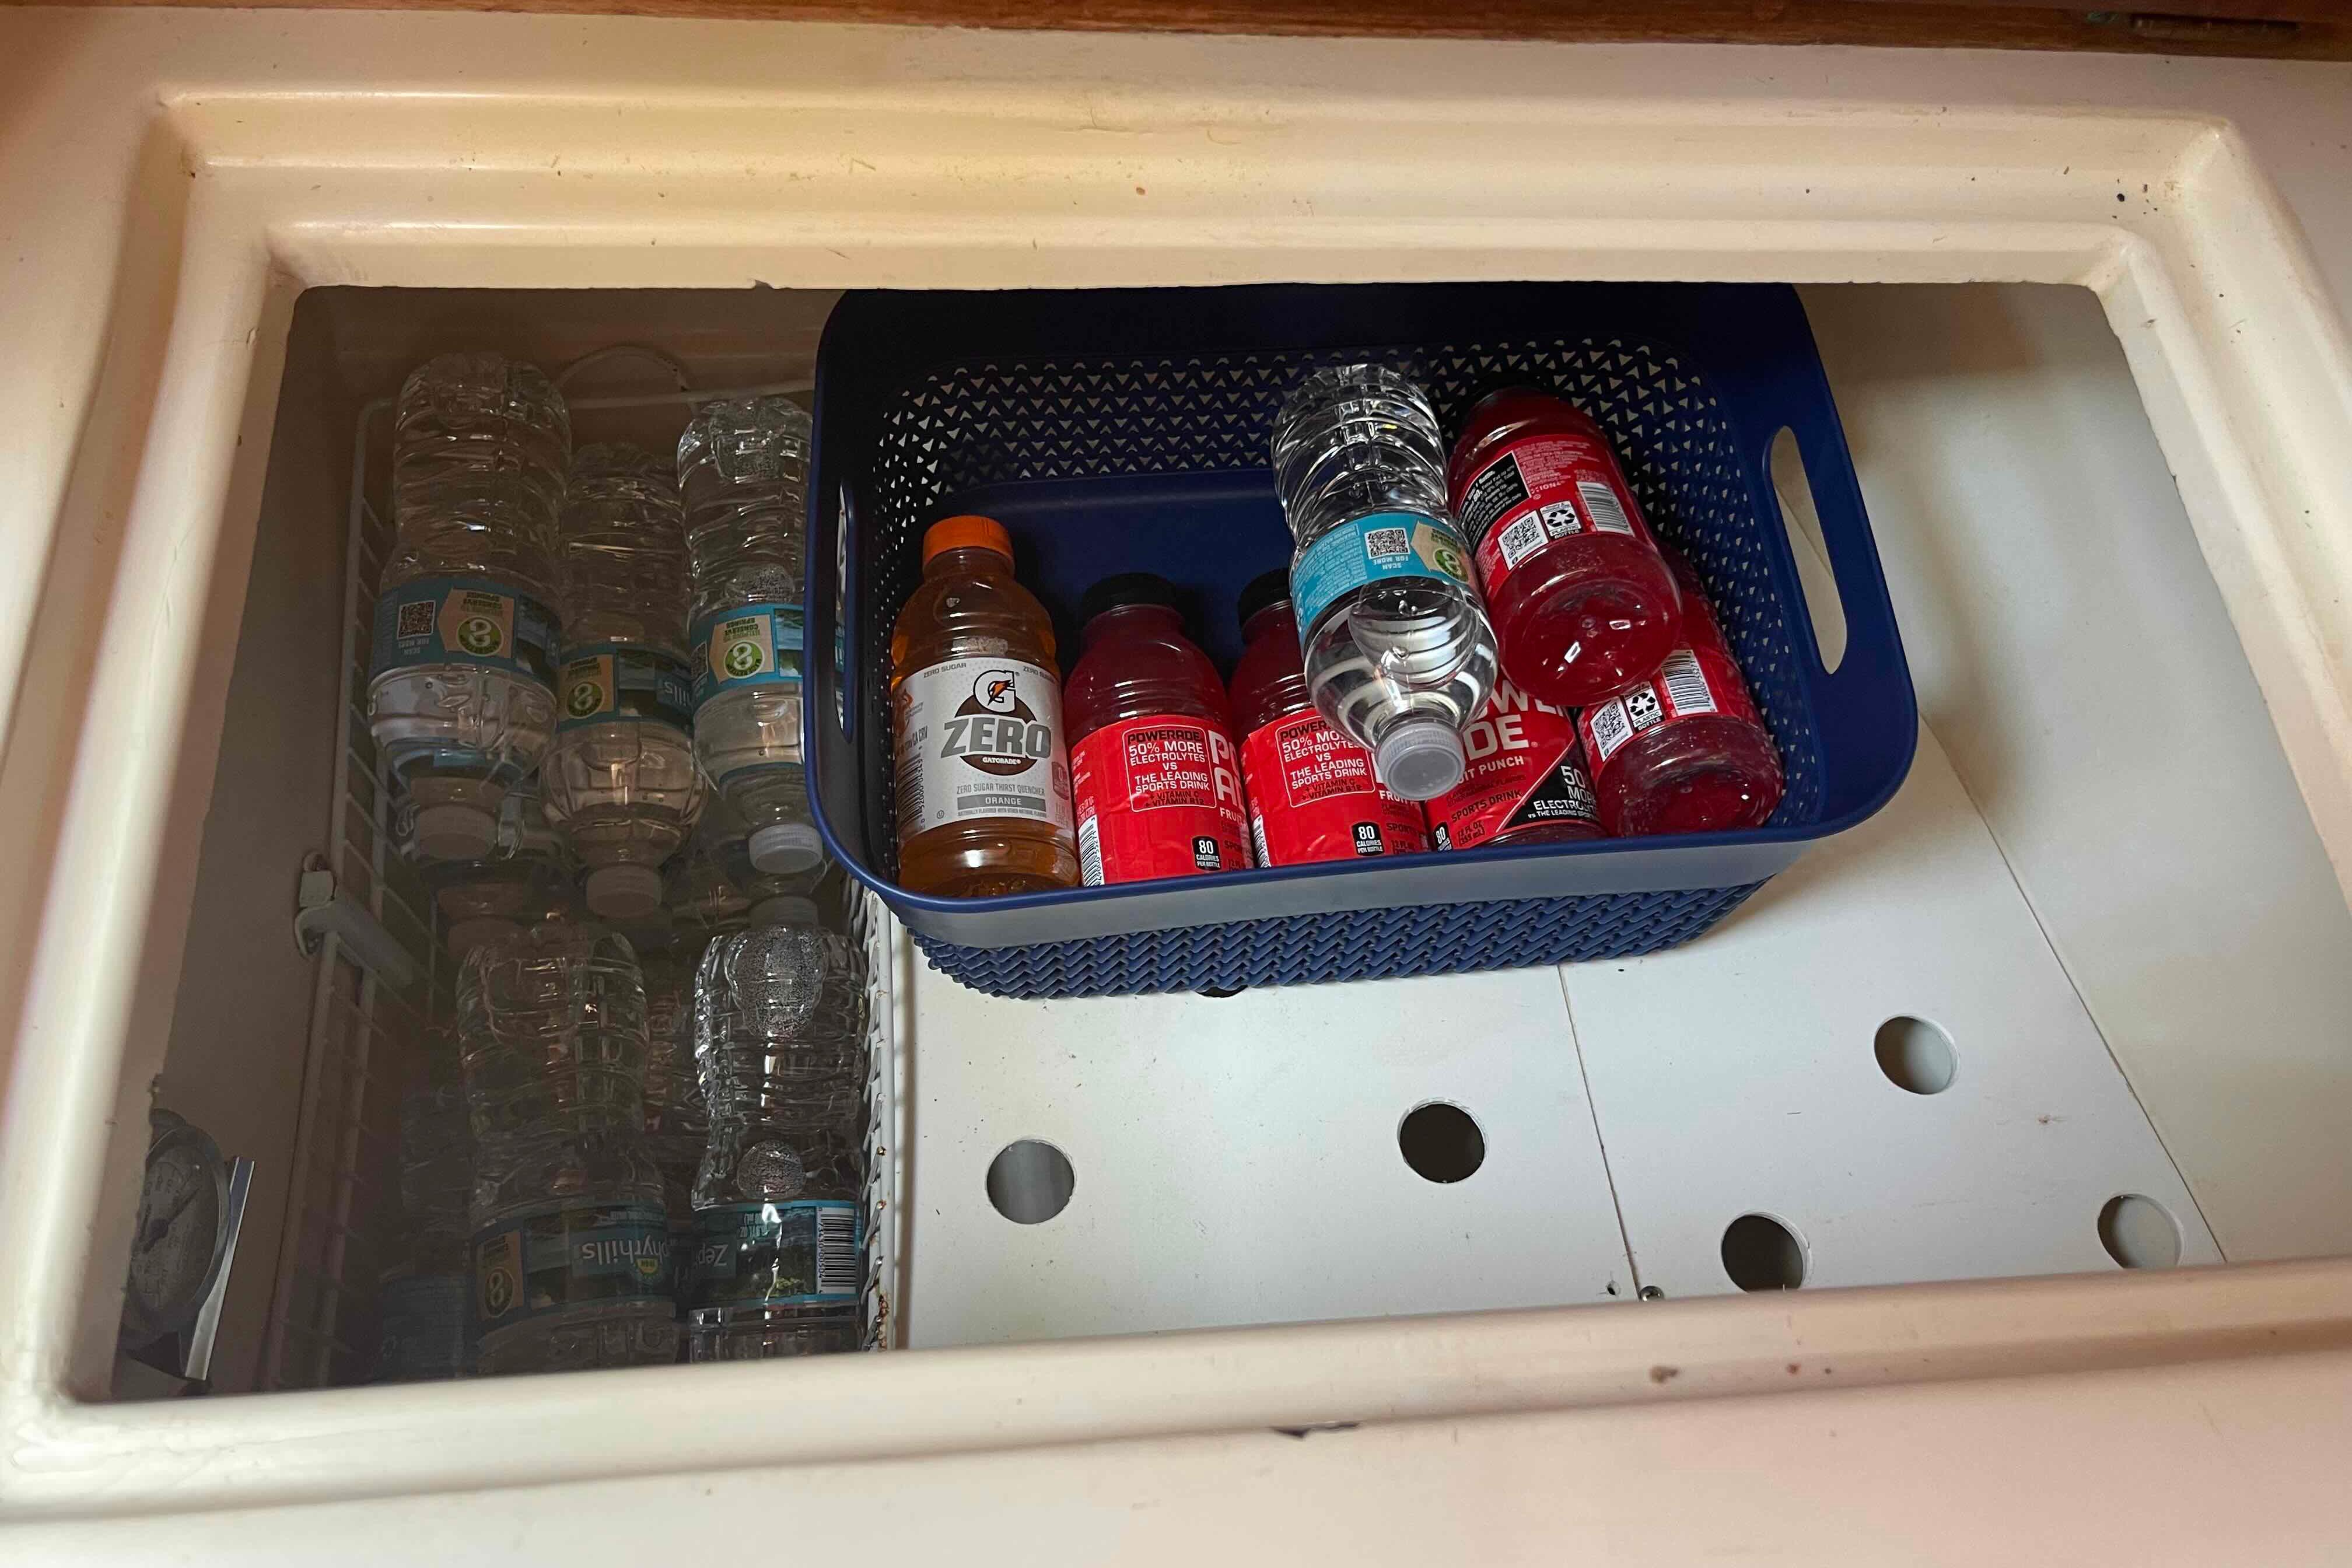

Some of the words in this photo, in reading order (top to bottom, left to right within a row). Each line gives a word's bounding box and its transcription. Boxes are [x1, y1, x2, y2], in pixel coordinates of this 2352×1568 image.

[1554, 529, 1580, 540] BOTTLE
[923, 666, 940, 678] ZERO
[941, 663, 967, 673] SUGAR
[1634, 711, 1660, 726] PLASTIC
[1637, 717, 1662, 731] BOTTLE
[940, 717, 1051, 758] ZERO
[1128, 730, 1200, 746] POWERADE
[1280, 720, 1331, 742] POWER
[1129, 742, 1160, 757] 50%
[1164, 740, 1204, 754] MORE
[1282, 736, 1312, 753] 50%
[1315, 730, 1343, 743] MO
[1130, 752, 1206, 766] ELECTROLYTES
[1316, 752, 1332, 762] VS
[1162, 762, 1178, 771] VS
[1290, 766, 1312, 780] THE
[1314, 758, 1364, 774] LEADING
[1479, 755, 1525, 775] PUNCH
[1135, 773, 1157, 785] THE
[1160, 771, 1208, 782] LEADING
[1292, 771, 1332, 789] SPORTS
[1334, 768, 1367, 778] DRINK
[956, 784, 972, 794] ZERO
[972, 783, 994, 793] SUGAR
[995, 783, 1016, 791] THIRST
[1017, 785, 1045, 796] QUENCHER
[1135, 780, 1177, 794] SPORTS
[1180, 780, 1210, 791] DRINK
[1308, 786, 1343, 799] VITAMIN
[1312, 779, 1348, 792] VITAMIN
[985, 797, 1021, 806] ORANGE
[1157, 790, 1191, 799] VITAMIN
[1152, 797, 1187, 807] VITAMIN
[1451, 799, 1487, 823] SPORTS
[1488, 789, 1522, 806] DRINK
[1358, 825, 1375, 839] 80
[1436, 826, 1446, 844] 80
[1199, 839, 1214, 855] 80
